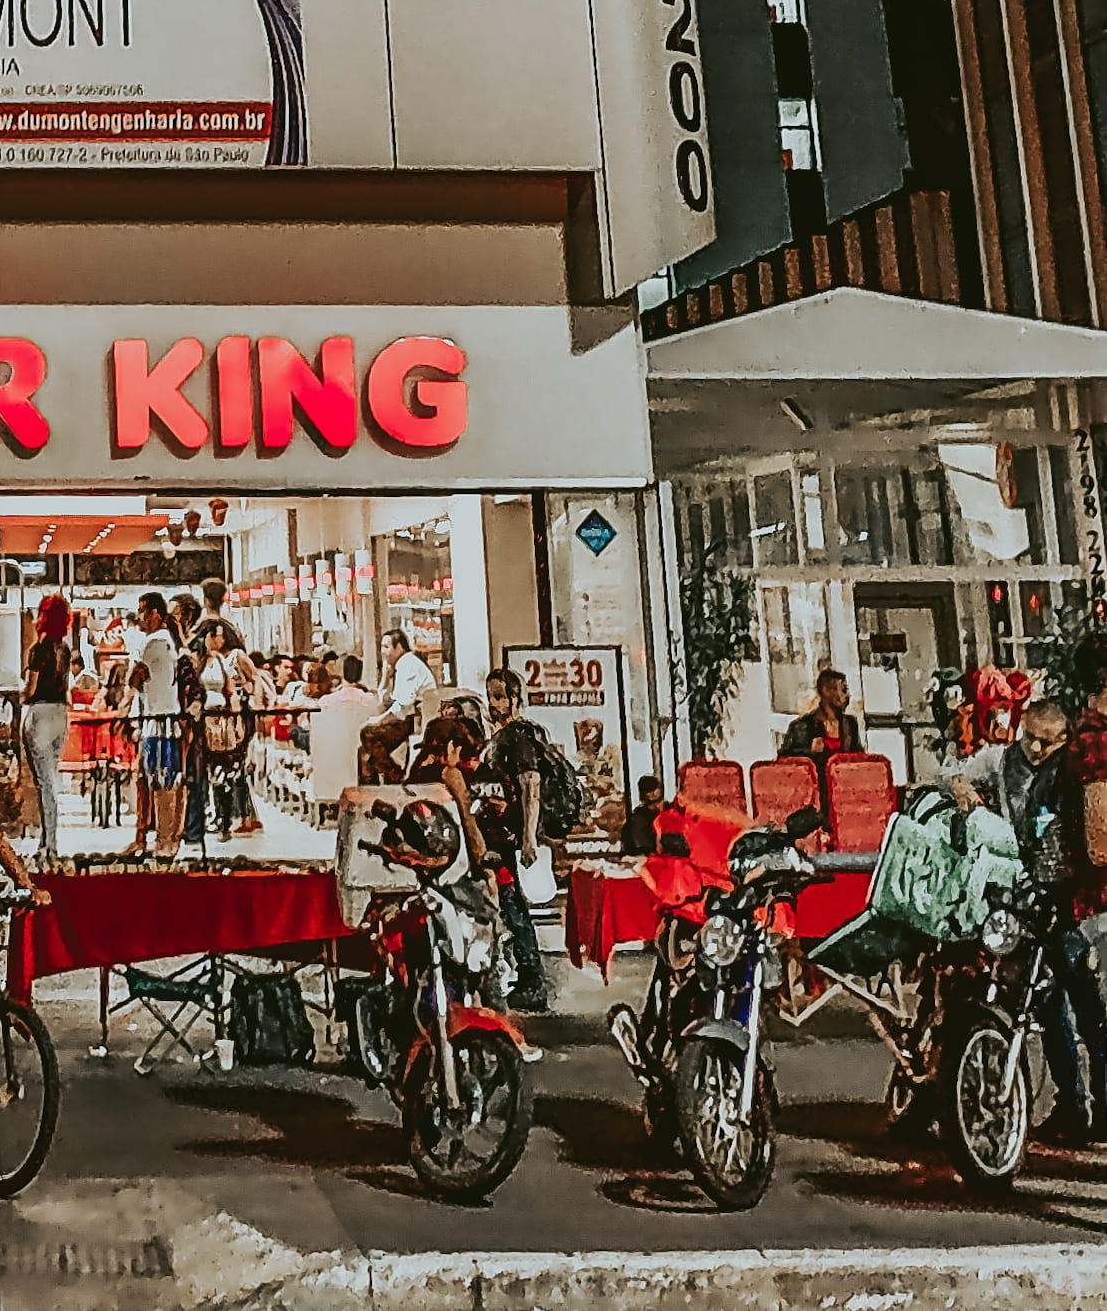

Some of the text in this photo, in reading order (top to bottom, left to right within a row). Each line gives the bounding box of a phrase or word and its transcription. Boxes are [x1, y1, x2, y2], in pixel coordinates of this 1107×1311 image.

[112, 334, 470, 457] KING
[524, 659, 542, 687] 2
[569, 659, 603, 687] 30
